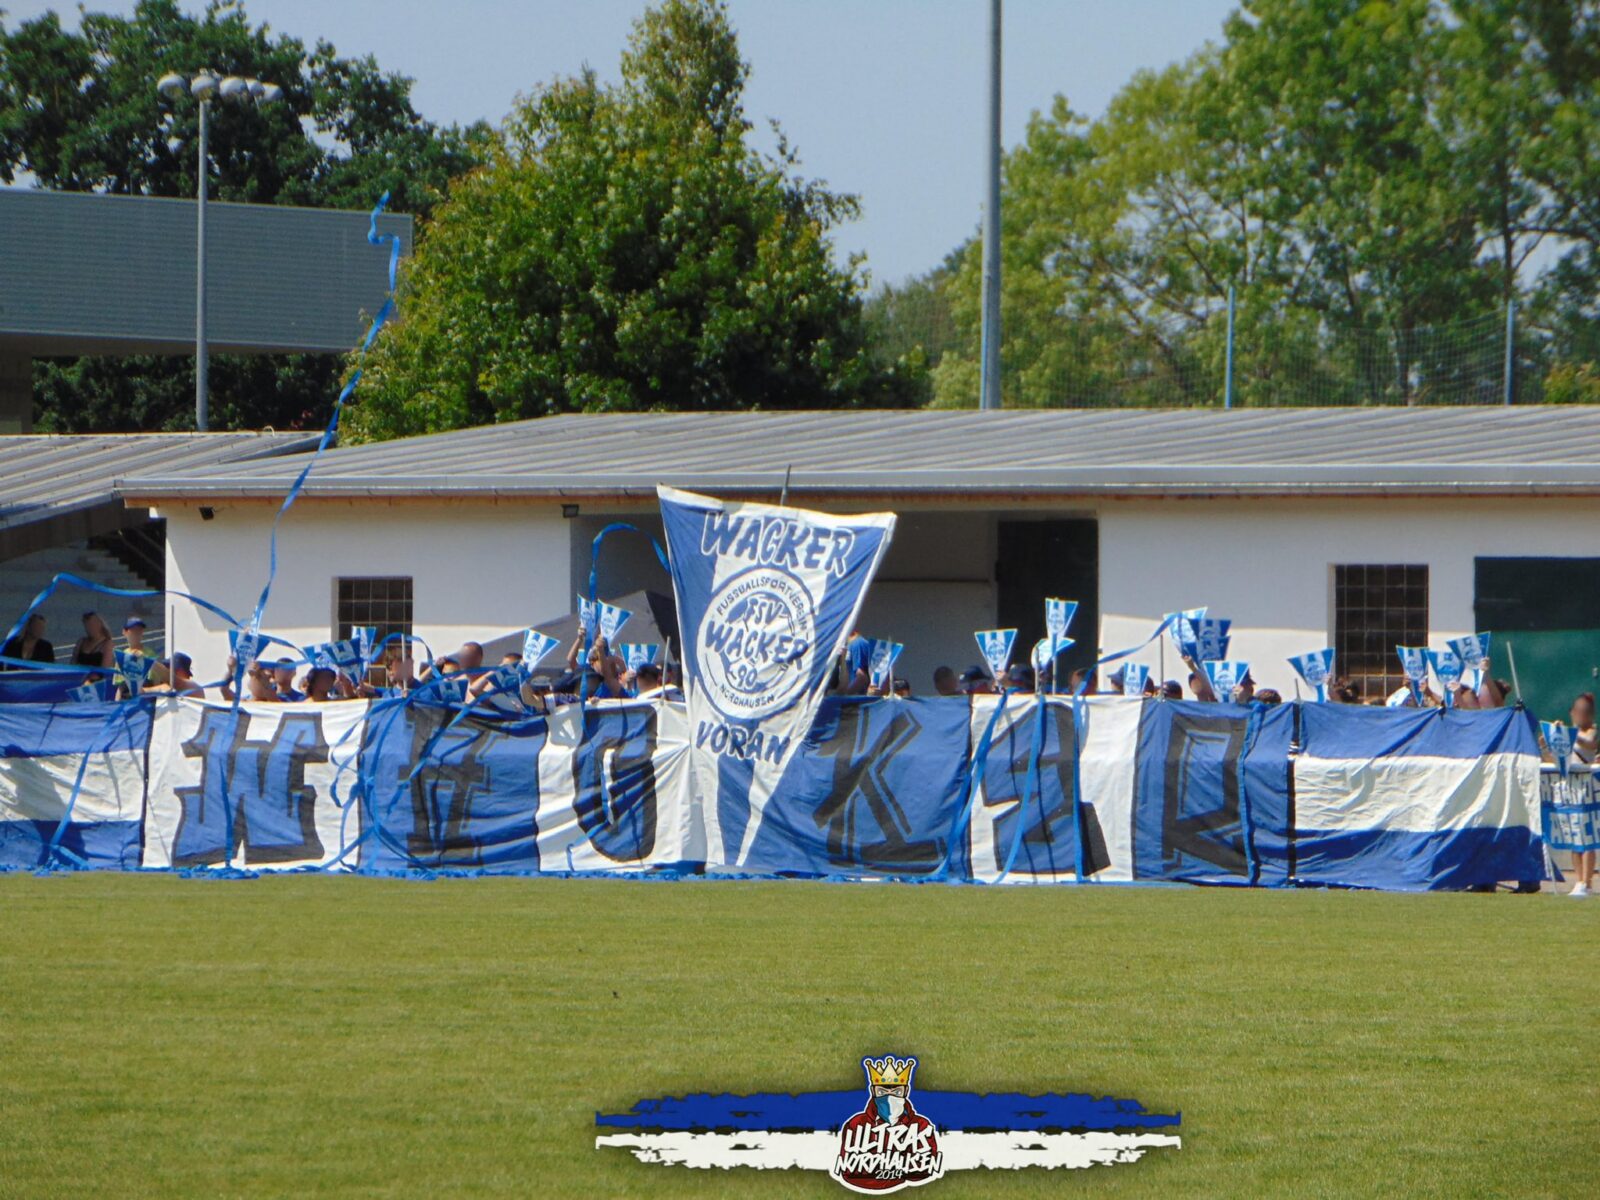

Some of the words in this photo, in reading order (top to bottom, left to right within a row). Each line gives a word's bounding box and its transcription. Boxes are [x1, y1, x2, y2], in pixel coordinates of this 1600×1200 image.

[702, 511, 854, 577] WACKER
[746, 597, 783, 625] FSV
[705, 620, 809, 670] WACKER
[737, 664, 758, 689] 90
[720, 683, 775, 708] NORDHAUSEN
[696, 720, 791, 765] VORAN
